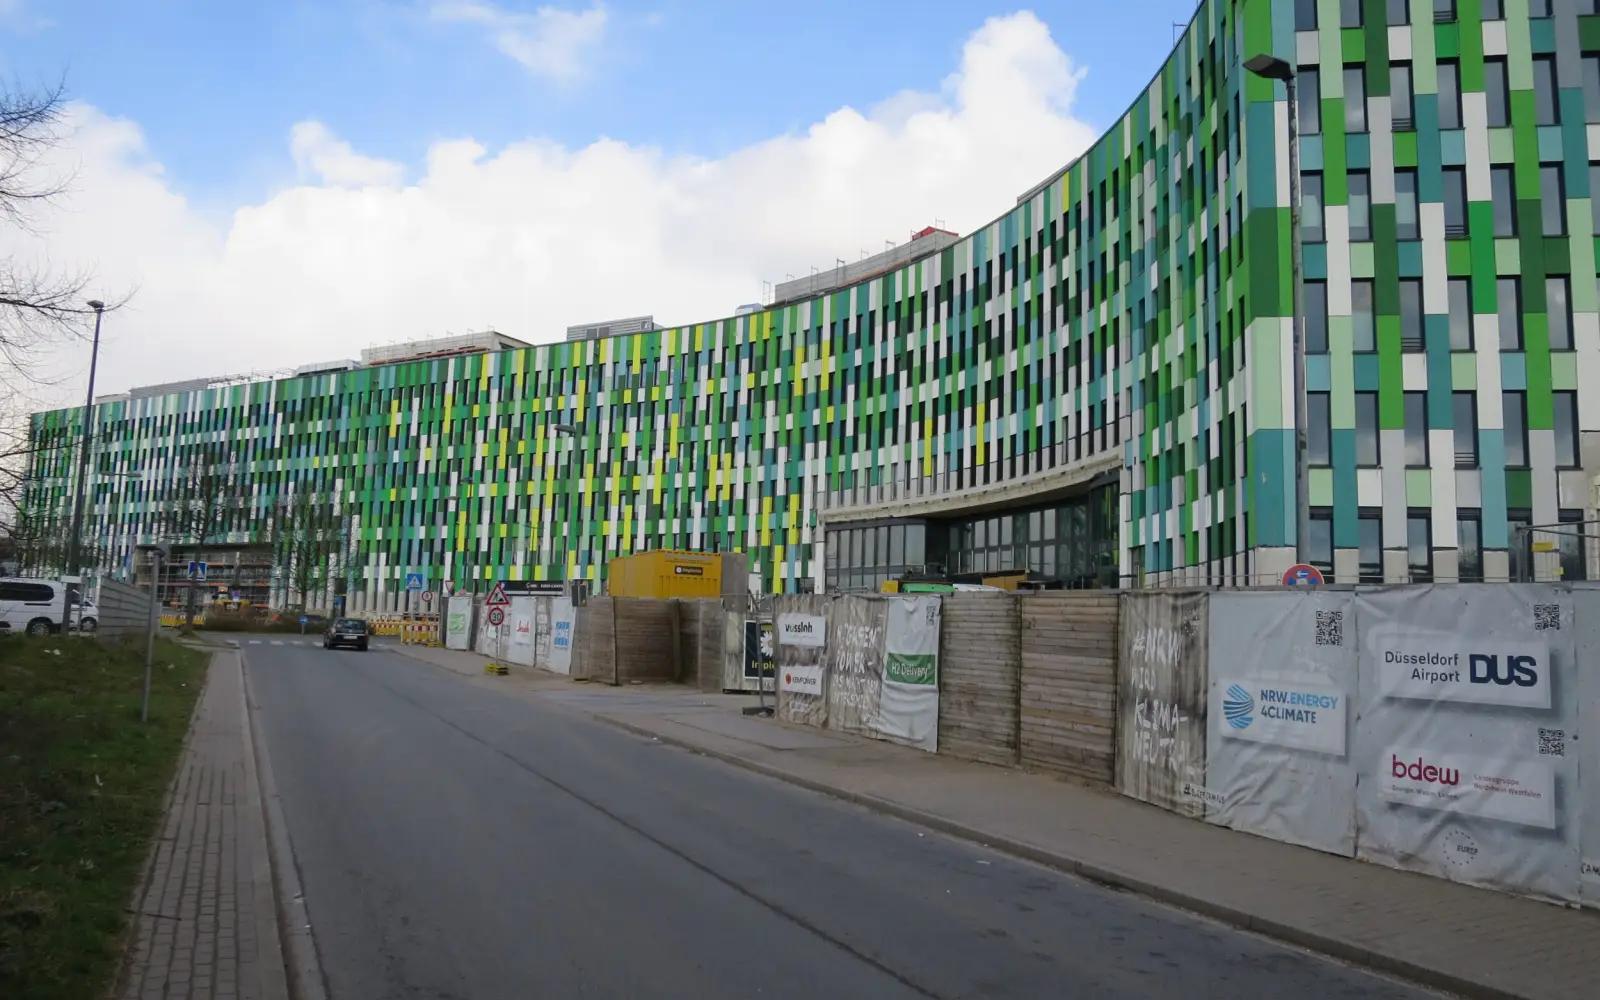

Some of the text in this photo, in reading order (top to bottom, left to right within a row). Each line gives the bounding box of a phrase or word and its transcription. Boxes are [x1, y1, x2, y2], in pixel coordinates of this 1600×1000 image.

[492, 612, 501, 622] 30
[1385, 651, 1459, 666] Düsseldorf
[1411, 668, 1460, 684] Airport
[1469, 653, 1538, 687] DUS
[1260, 689, 1338, 710] NRW.ENERGY
[1261, 706, 1317, 724] 4CLIMATE
[1392, 754, 1460, 786] bdew
